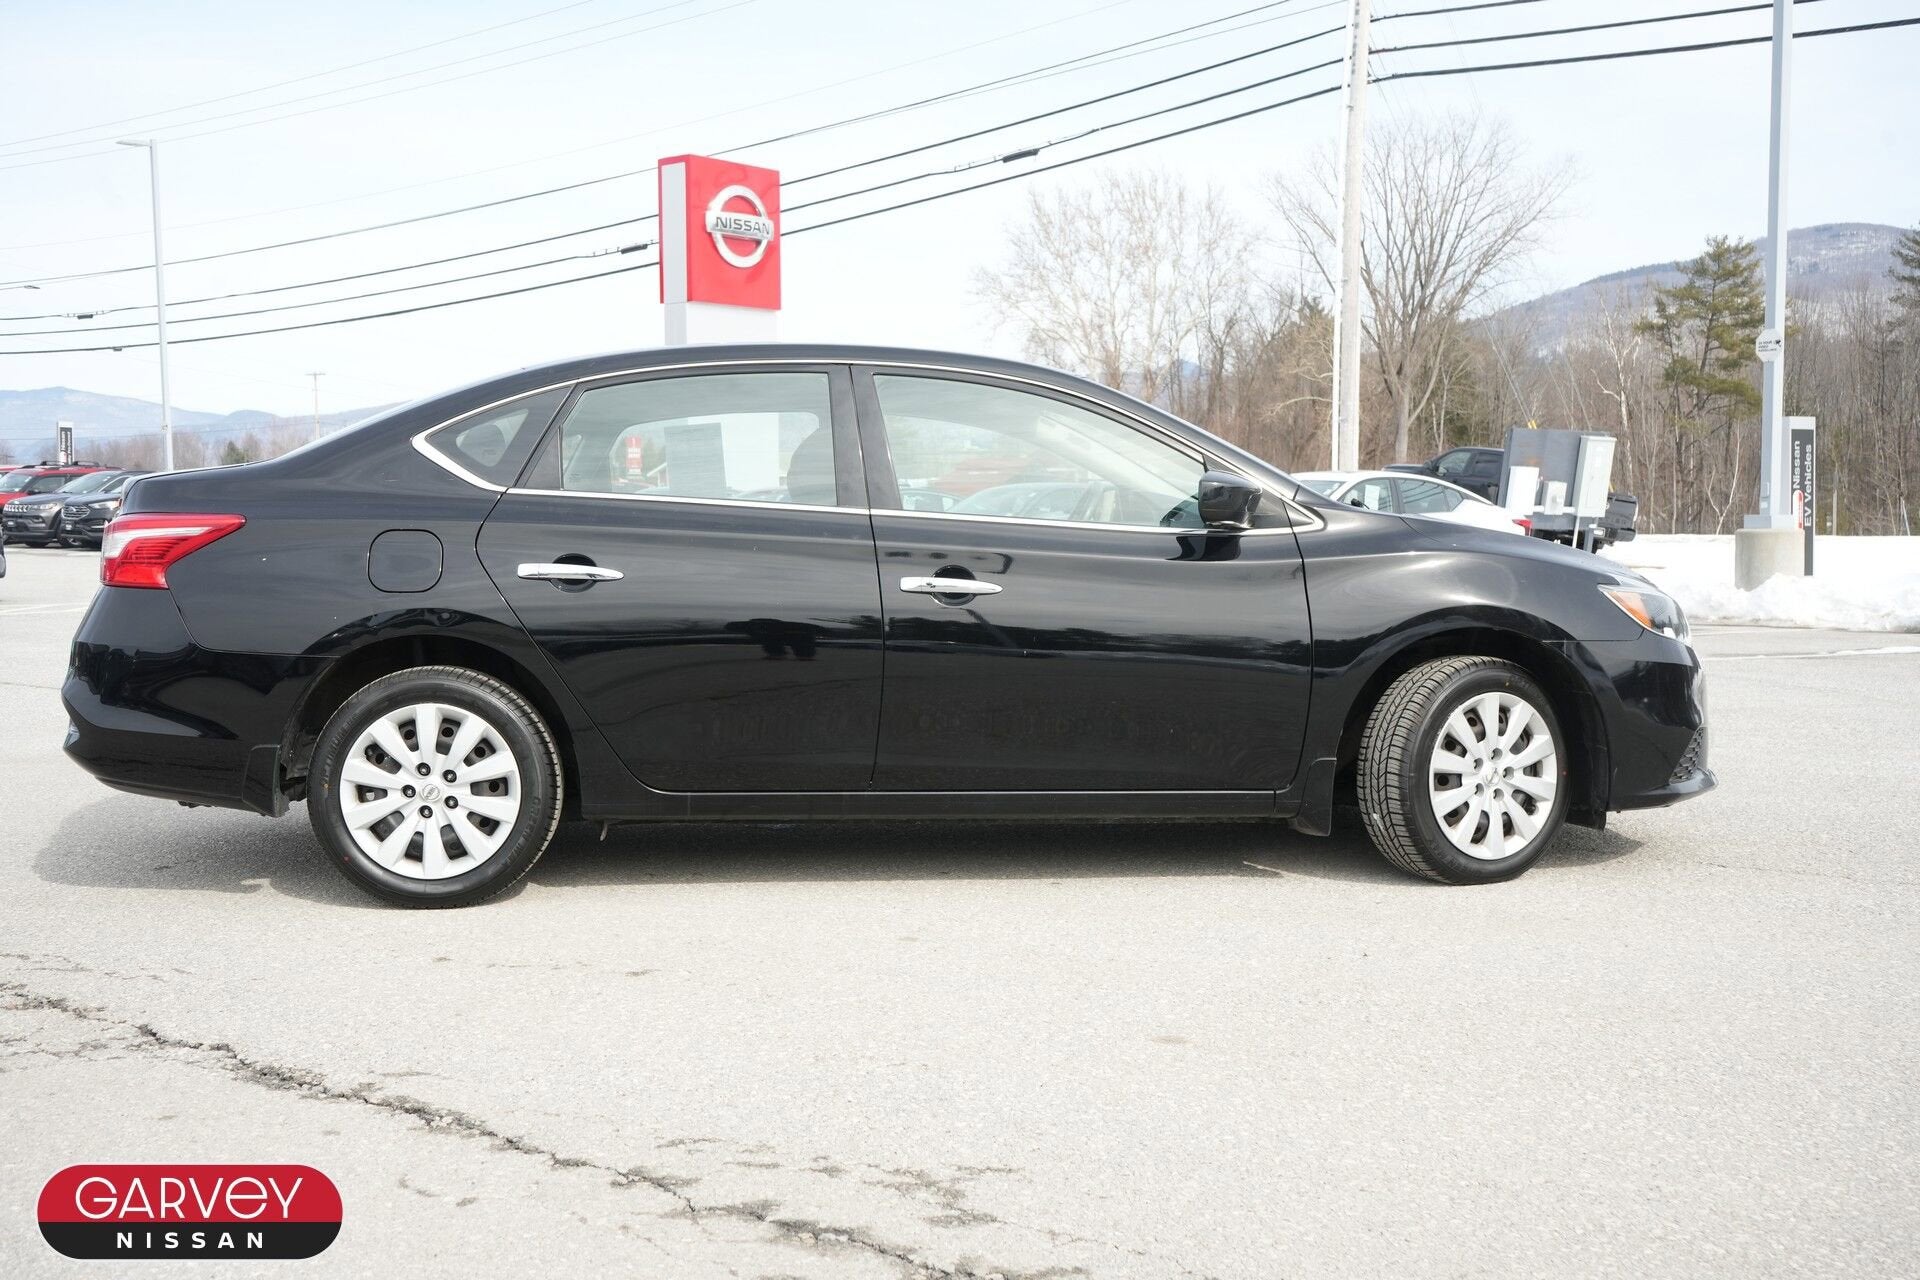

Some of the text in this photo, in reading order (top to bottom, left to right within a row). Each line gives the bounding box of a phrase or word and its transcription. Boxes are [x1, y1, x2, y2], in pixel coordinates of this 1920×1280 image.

[715, 216, 770, 235] NISSAN
[1804, 444, 1812, 527] EV Vehicles
